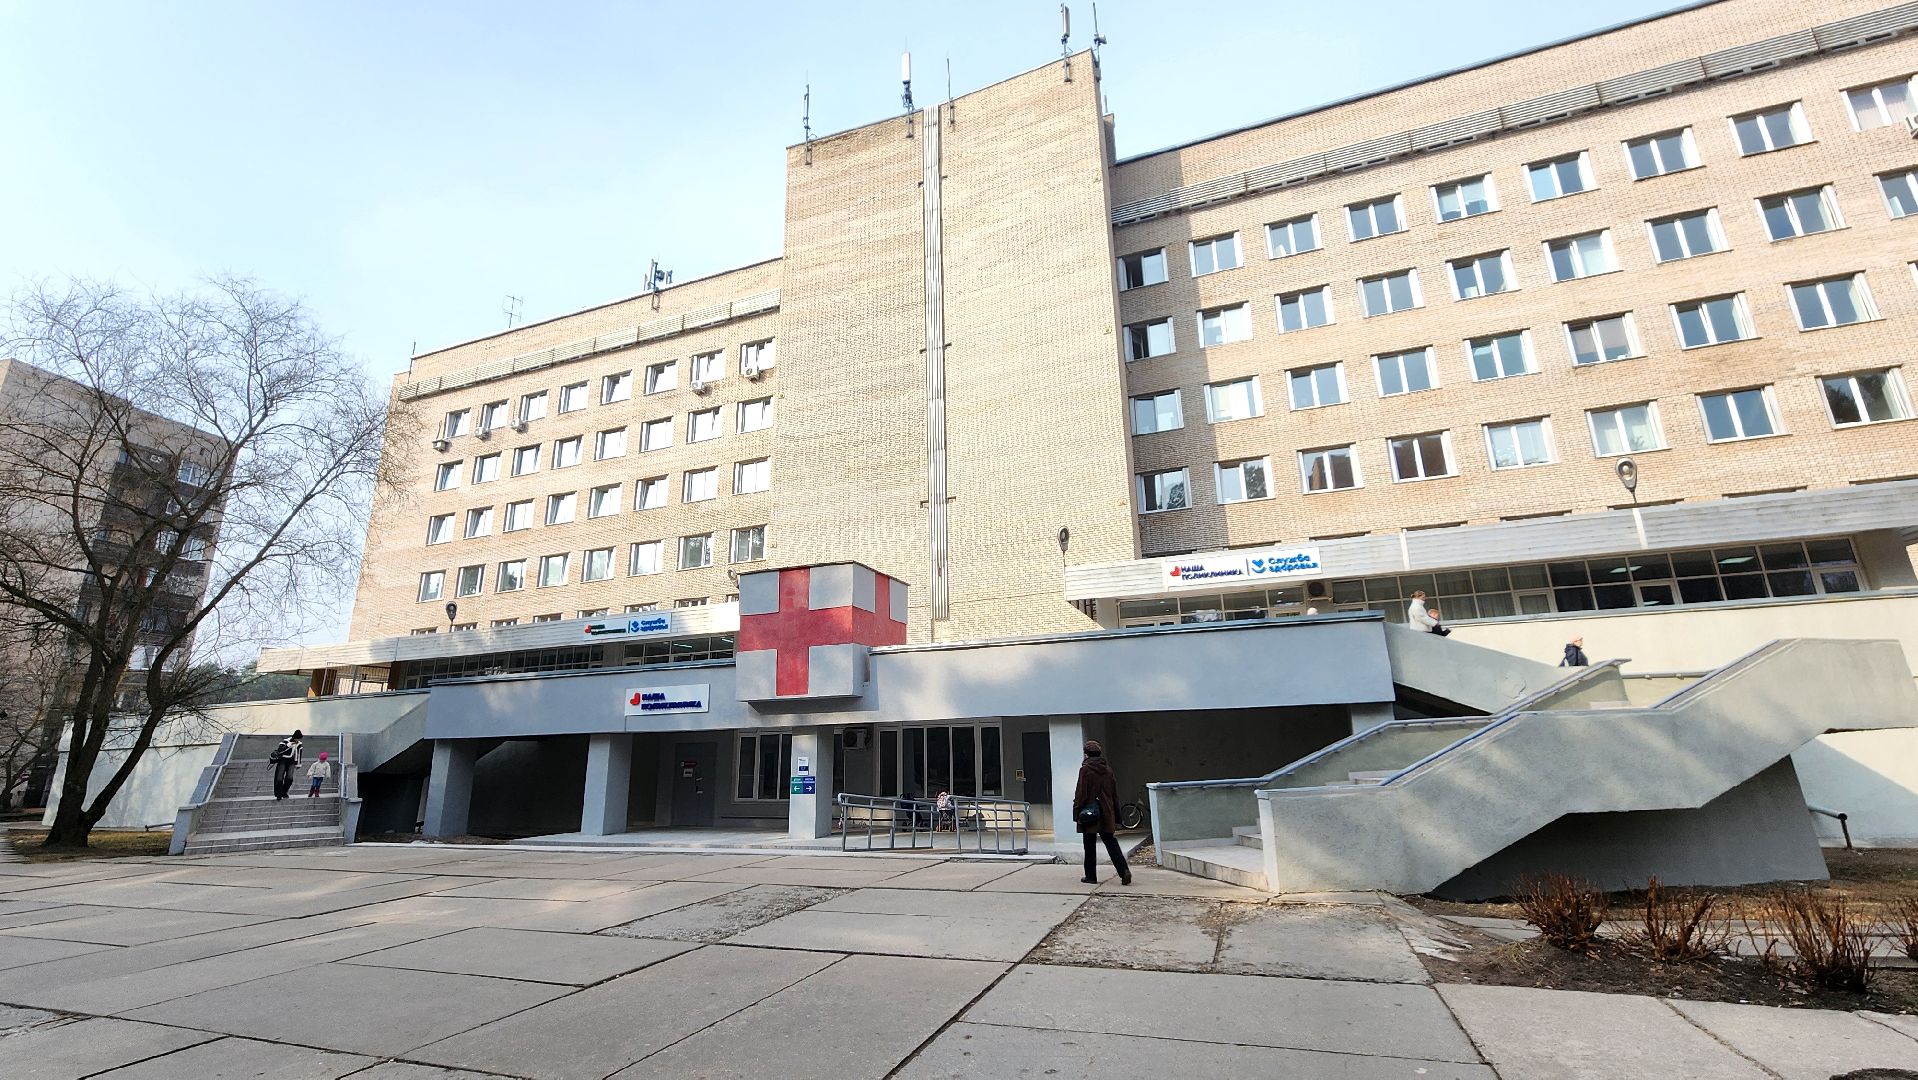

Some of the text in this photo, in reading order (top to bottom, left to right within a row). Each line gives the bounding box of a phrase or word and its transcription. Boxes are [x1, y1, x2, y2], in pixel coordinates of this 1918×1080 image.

[1268, 553, 1311, 565] Служба
[1181, 564, 1205, 573] НАША
[1268, 562, 1319, 573] здоровья
[1181, 569, 1244, 580] ПОЛИКЛИНИКА
